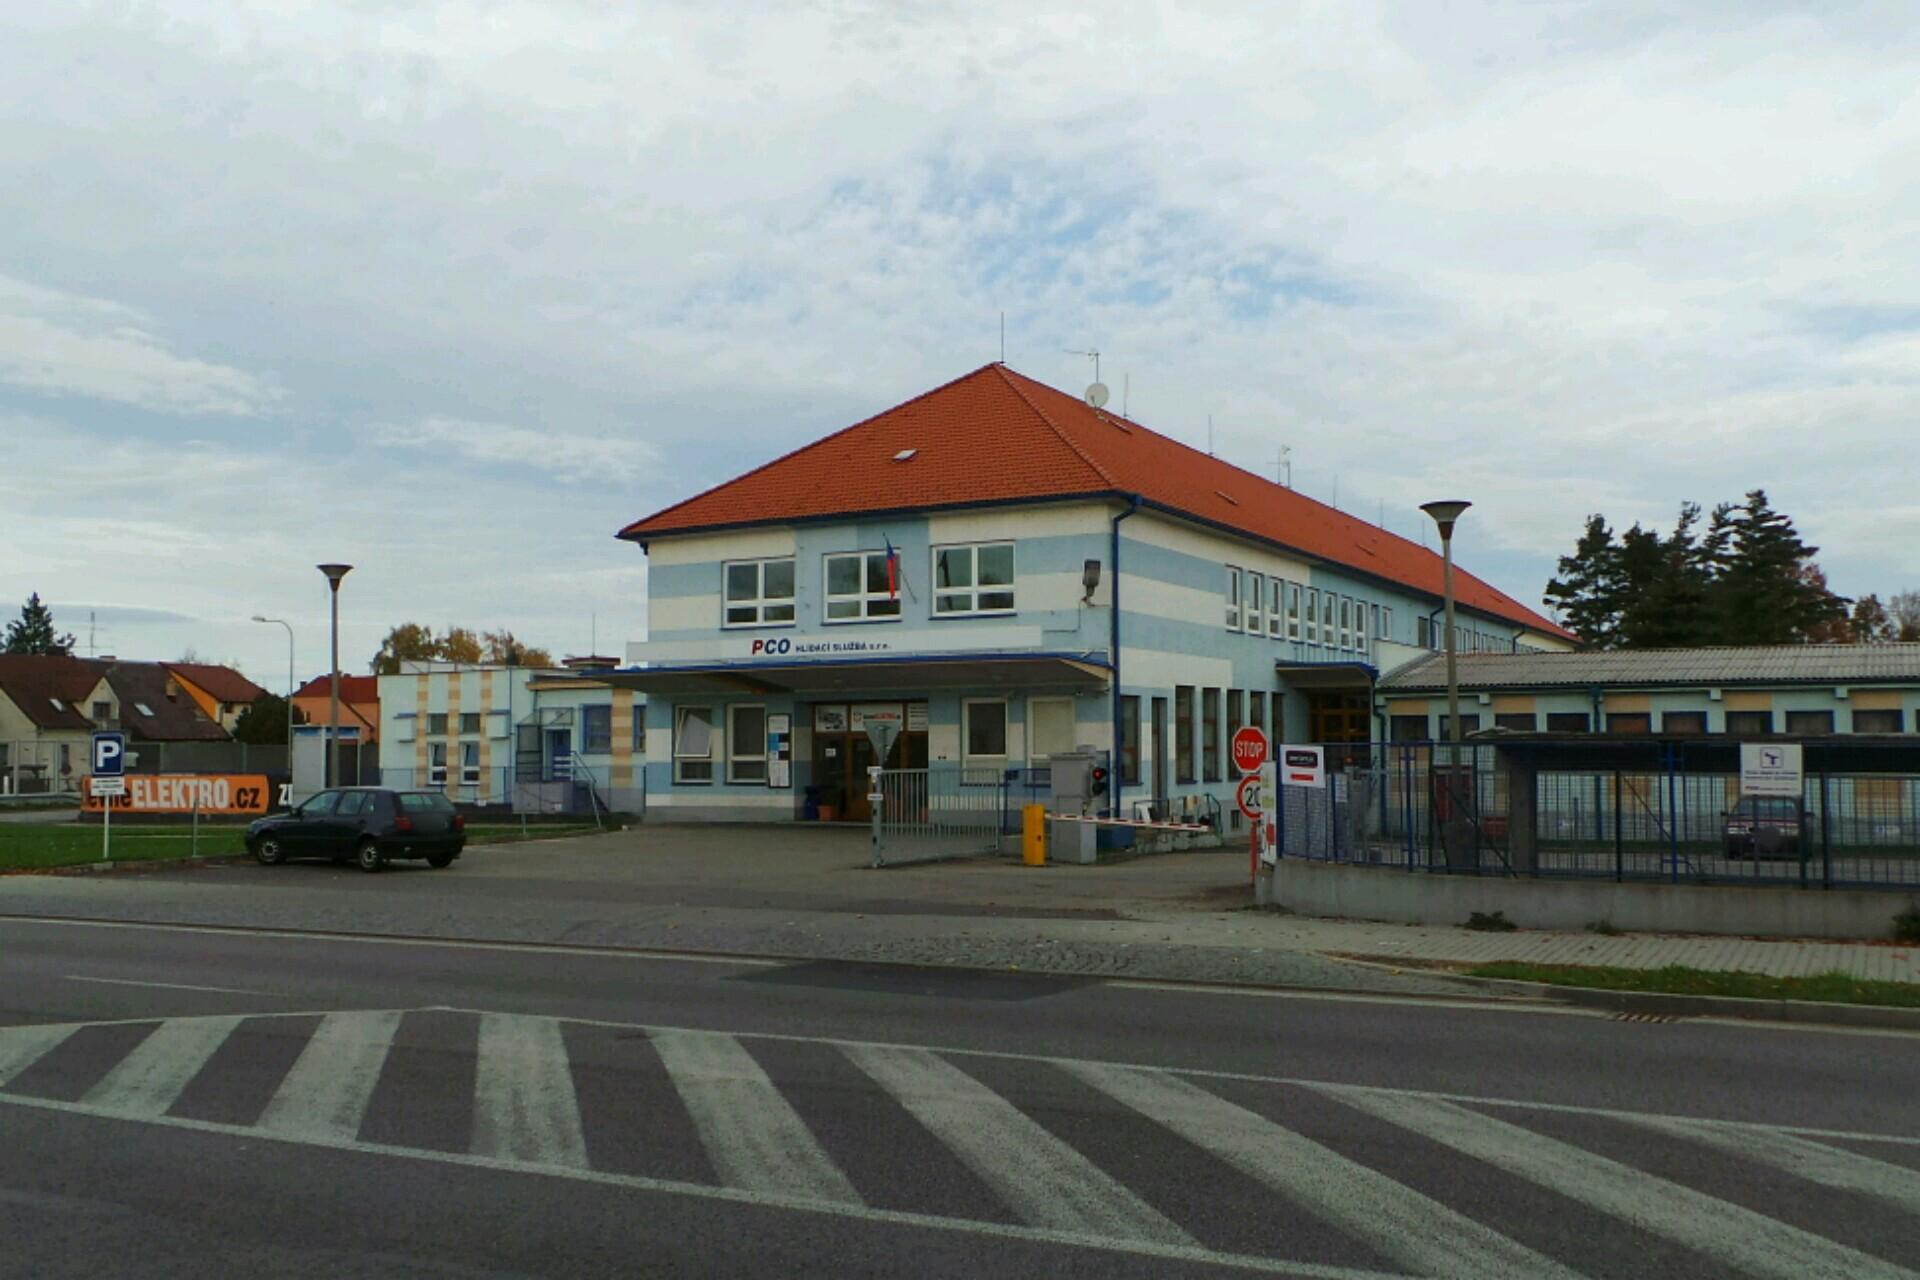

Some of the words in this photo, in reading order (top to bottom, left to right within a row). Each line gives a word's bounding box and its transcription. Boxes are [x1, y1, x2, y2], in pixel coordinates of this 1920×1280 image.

[752, 638, 791, 655] PCO
[96, 740, 120, 768] P
[1236, 741, 1263, 758] STOP
